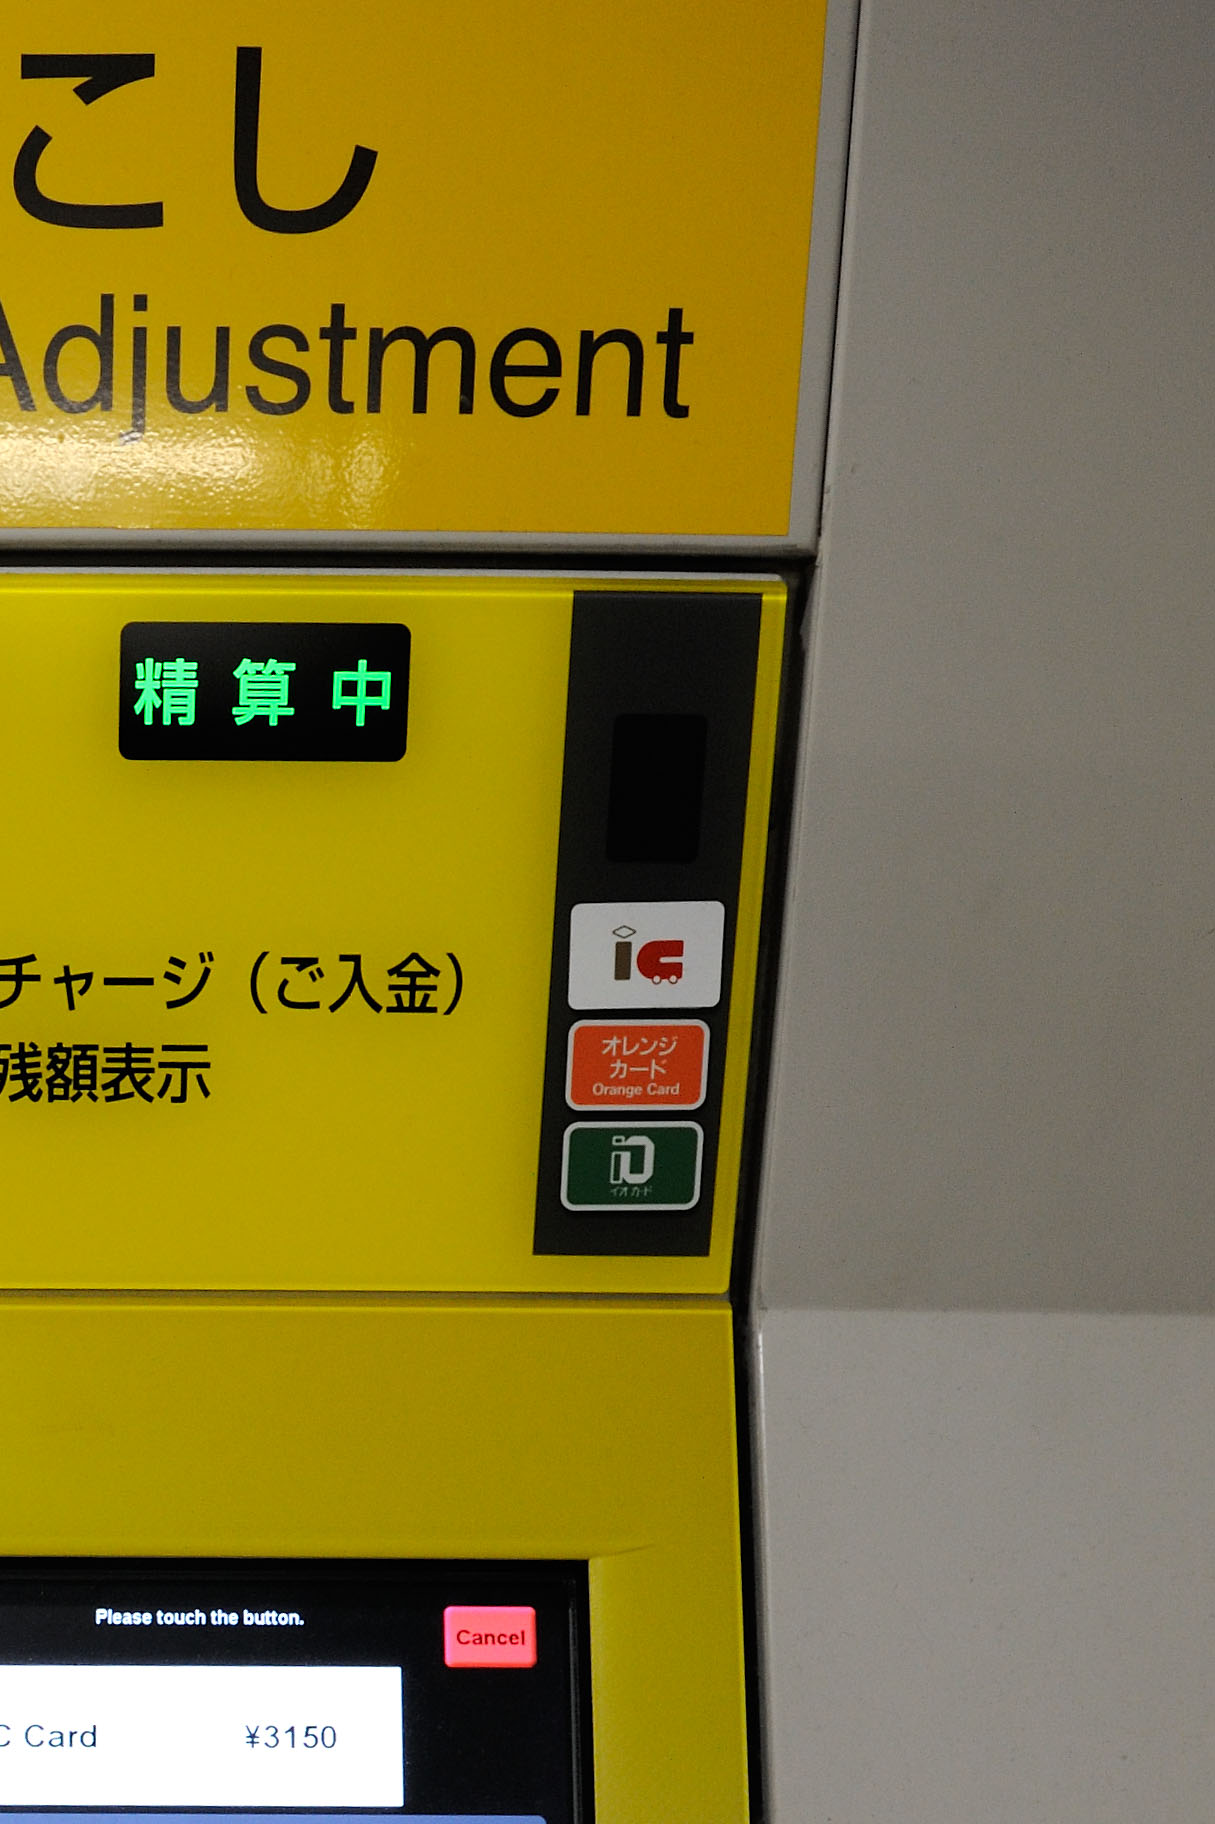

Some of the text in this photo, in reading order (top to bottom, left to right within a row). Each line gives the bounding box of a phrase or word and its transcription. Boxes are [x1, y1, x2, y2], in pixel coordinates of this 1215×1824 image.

[602, 1036, 677, 1056] オレンジ
[610, 1059, 666, 1079] カード
[592, 1083, 680, 1098] Orange Card
[96, 1608, 304, 1625] Please touch the button.
[457, 1630, 525, 1645] Cancel
[25, 1725, 96, 1747] Card
[246, 1726, 336, 1748] ¥3150
